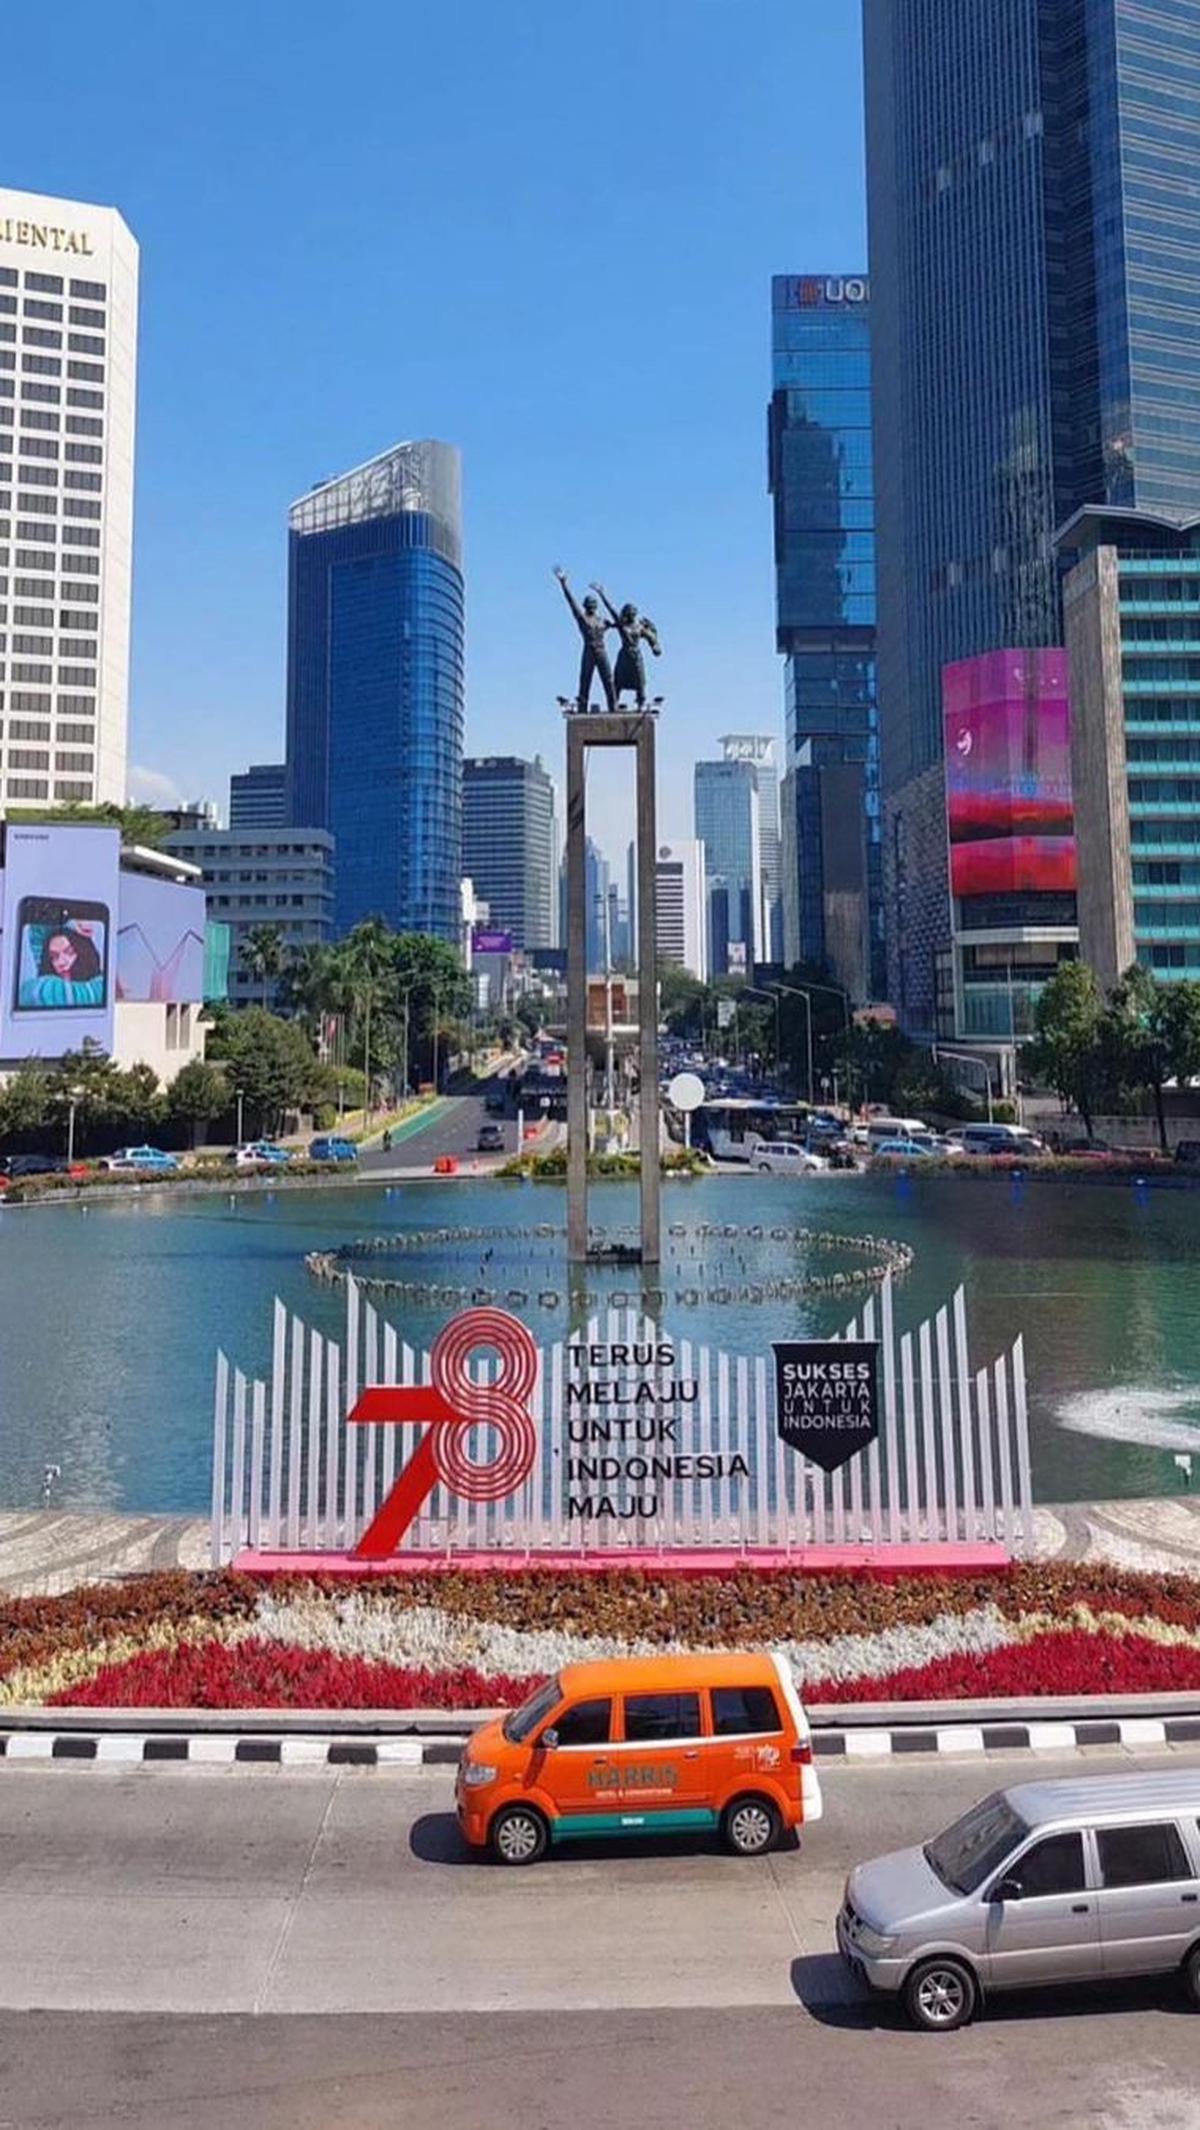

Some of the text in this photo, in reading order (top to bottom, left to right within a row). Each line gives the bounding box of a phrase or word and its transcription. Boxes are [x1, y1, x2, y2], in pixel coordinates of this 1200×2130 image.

[0, 219, 93, 255] IENTAL
[826, 279, 870, 301] UO
[567, 1344, 675, 1367] TERUS
[784, 1363, 870, 1379] SUKSES
[566, 1380, 699, 1404] MELAJU
[783, 1382, 870, 1399] JAKARTA
[783, 1400, 870, 1414] UNTUK
[567, 1418, 677, 1442] UNTUK
[783, 1414, 871, 1429] INDONESIA
[347, 1307, 537, 1560] 78
[567, 1454, 749, 1481] INDONESIA
[567, 1496, 658, 1519] MAJU
